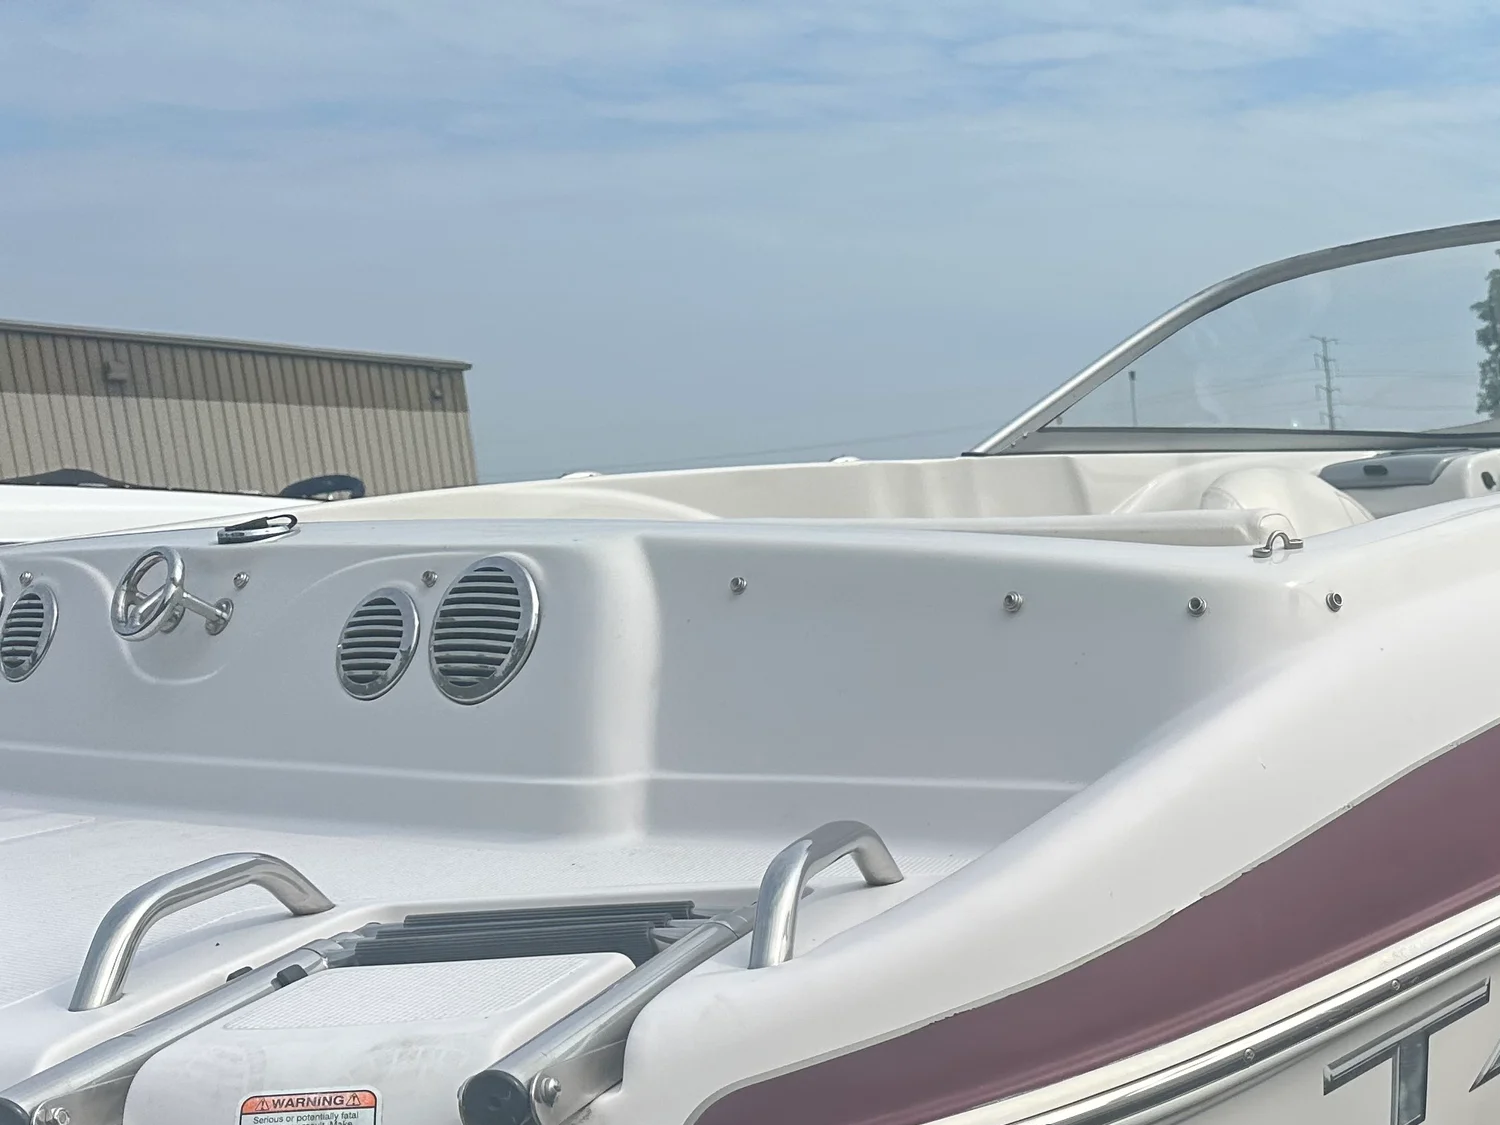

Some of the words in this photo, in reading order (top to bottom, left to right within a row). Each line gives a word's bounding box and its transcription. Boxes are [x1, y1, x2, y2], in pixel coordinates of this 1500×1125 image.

[272, 1095, 344, 1108] WARNING
[253, 1116, 284, 1124] Serious
[297, 1112, 338, 1123] potentially
[341, 1111, 359, 1119] fatal
